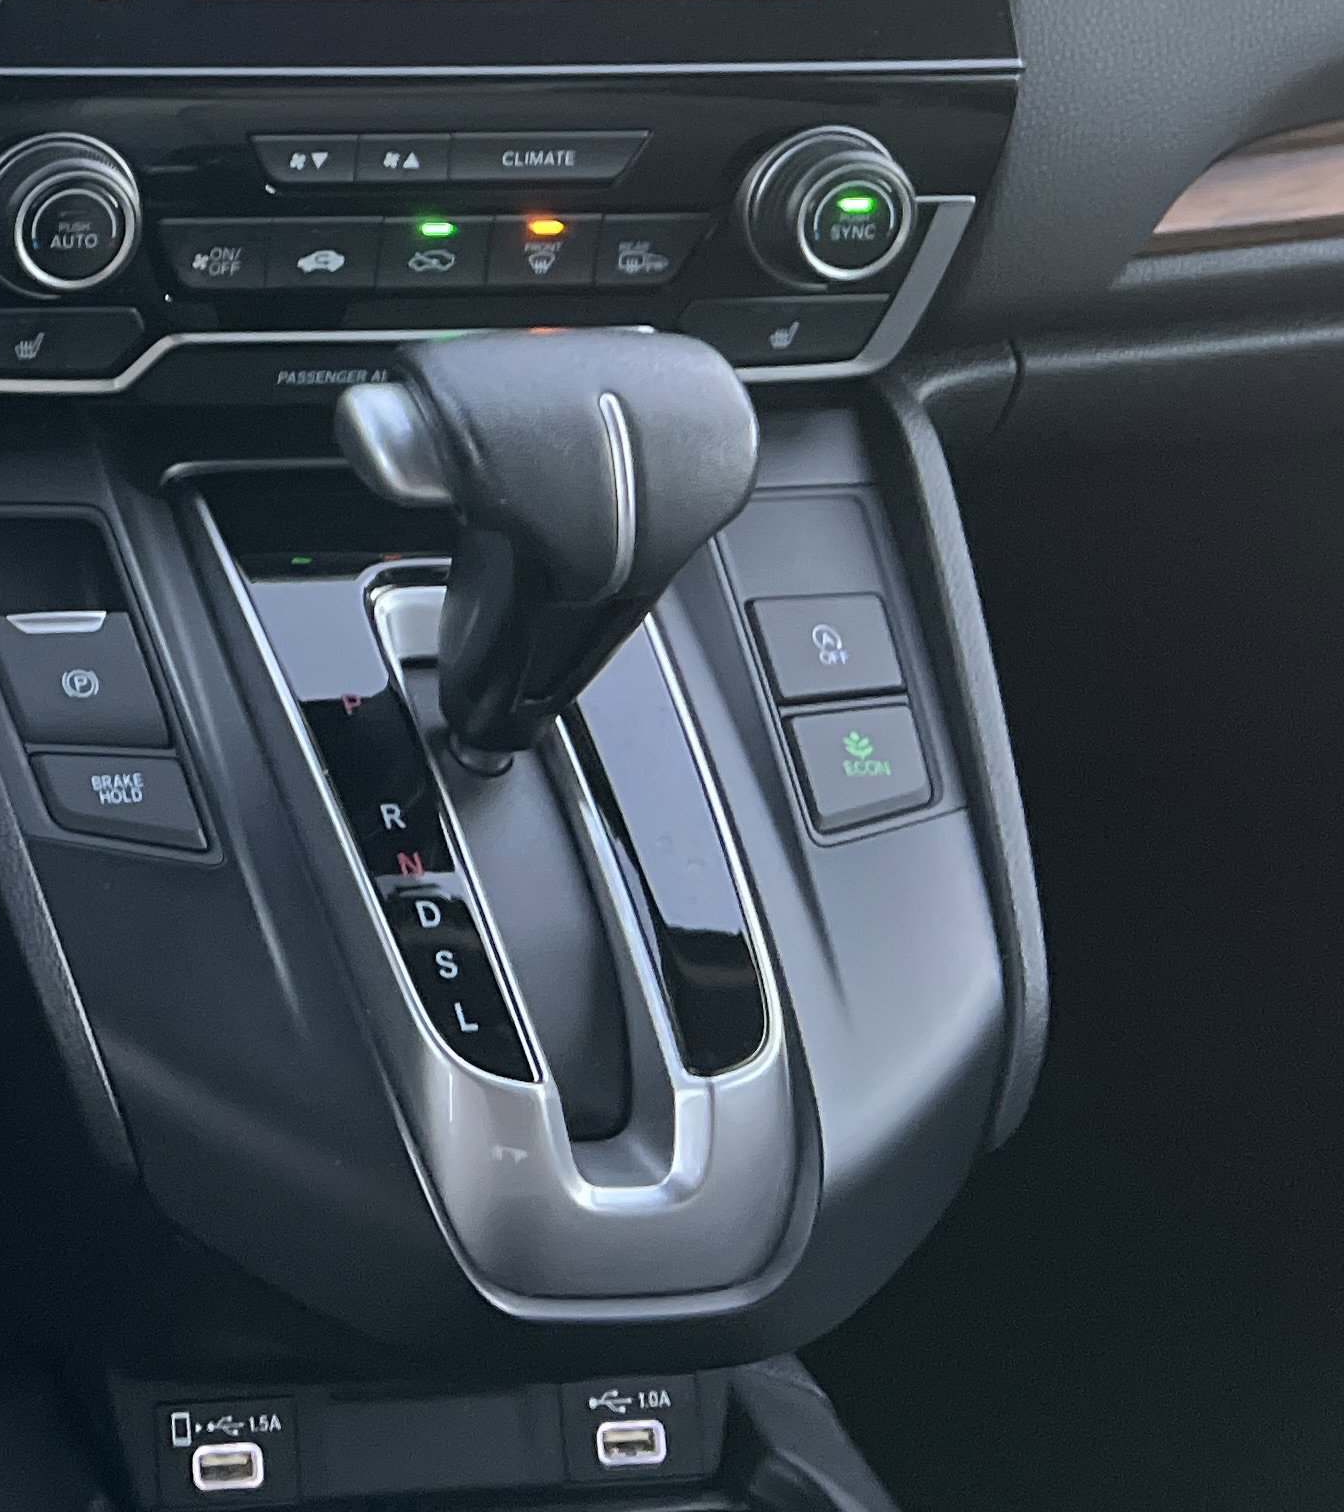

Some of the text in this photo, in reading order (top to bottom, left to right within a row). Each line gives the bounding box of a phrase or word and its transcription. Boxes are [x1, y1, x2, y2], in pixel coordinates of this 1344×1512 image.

[501, 149, 576, 167] CLIMATE
[830, 223, 877, 240] SYNC
[50, 233, 98, 249] AUTO
[208, 260, 241, 277] OFF
[276, 369, 368, 385] PASSENGER
[819, 649, 849, 665] OFF
[342, 694, 363, 716] P
[843, 759, 892, 777] ECON
[91, 772, 144, 791] BRAKE
[98, 787, 143, 805] HOLD
[380, 803, 407, 830] R
[397, 851, 425, 877] N
[415, 900, 441, 928] D
[435, 950, 459, 979] S
[454, 1002, 479, 1032] L
[638, 1391, 672, 1409] 1.0A
[248, 1414, 283, 1433] 1.5A
